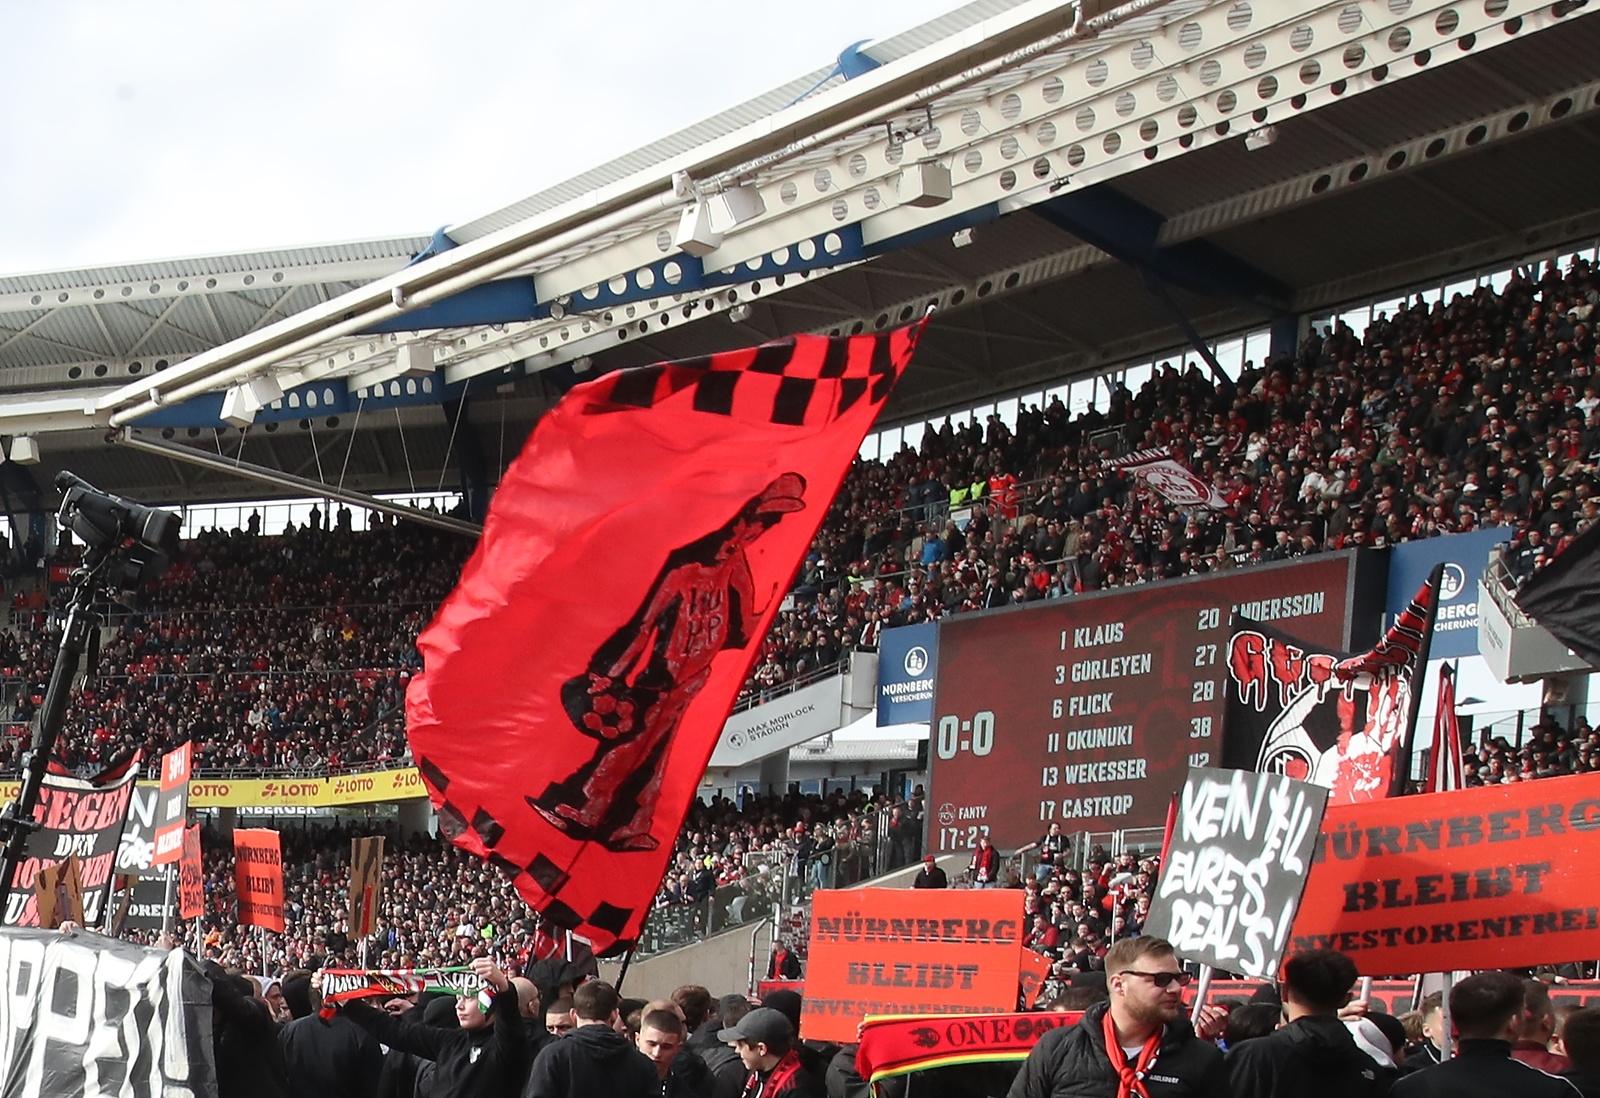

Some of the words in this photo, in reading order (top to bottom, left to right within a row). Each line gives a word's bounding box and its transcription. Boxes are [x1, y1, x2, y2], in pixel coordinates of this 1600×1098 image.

[1198, 608, 1220, 630] 20
[1061, 631, 1067, 650] 1
[1074, 622, 1125, 649] KLAUS
[1055, 665, 1065, 685] 3
[1072, 653, 1152, 682] GÜRLEYEN
[1195, 645, 1217, 666] 27
[1192, 681, 1215, 702] 28
[1053, 699, 1063, 718] 6
[1069, 693, 1113, 716] FLICK
[747, 722, 768, 736] MAX
[769, 704, 816, 725] MORLOCK
[750, 721, 790, 742] STADION
[1190, 717, 1212, 738] 38
[938, 711, 995, 760] 0:0
[1048, 733, 1059, 752] 11
[1067, 725, 1133, 751] OKUNUKI
[344, 779, 374, 793] LOTTO
[1042, 767, 1058, 786] 13
[1065, 759, 1147, 785] WEKESSER
[280, 782, 319, 797] LOTTO
[33, 780, 133, 832] GEGEN
[958, 805, 988, 820] FANTY
[1039, 800, 1056, 821] 17
[1062, 795, 1133, 819] CASTROP
[1181, 769, 1270, 844] KEIN
[53, 833, 100, 857] DEN
[245, 875, 275, 896] BLEIBT
[1160, 846, 1270, 926] EURES
[1342, 861, 1551, 913] BLEIBT
[816, 911, 1016, 945] NÜRNBERG
[1168, 898, 1294, 977] DEALS!
[1292, 906, 1600, 953] NVESTORENFREI
[847, 962, 979, 990] BLEIBT
[945, 1019, 1012, 1048] ONE
